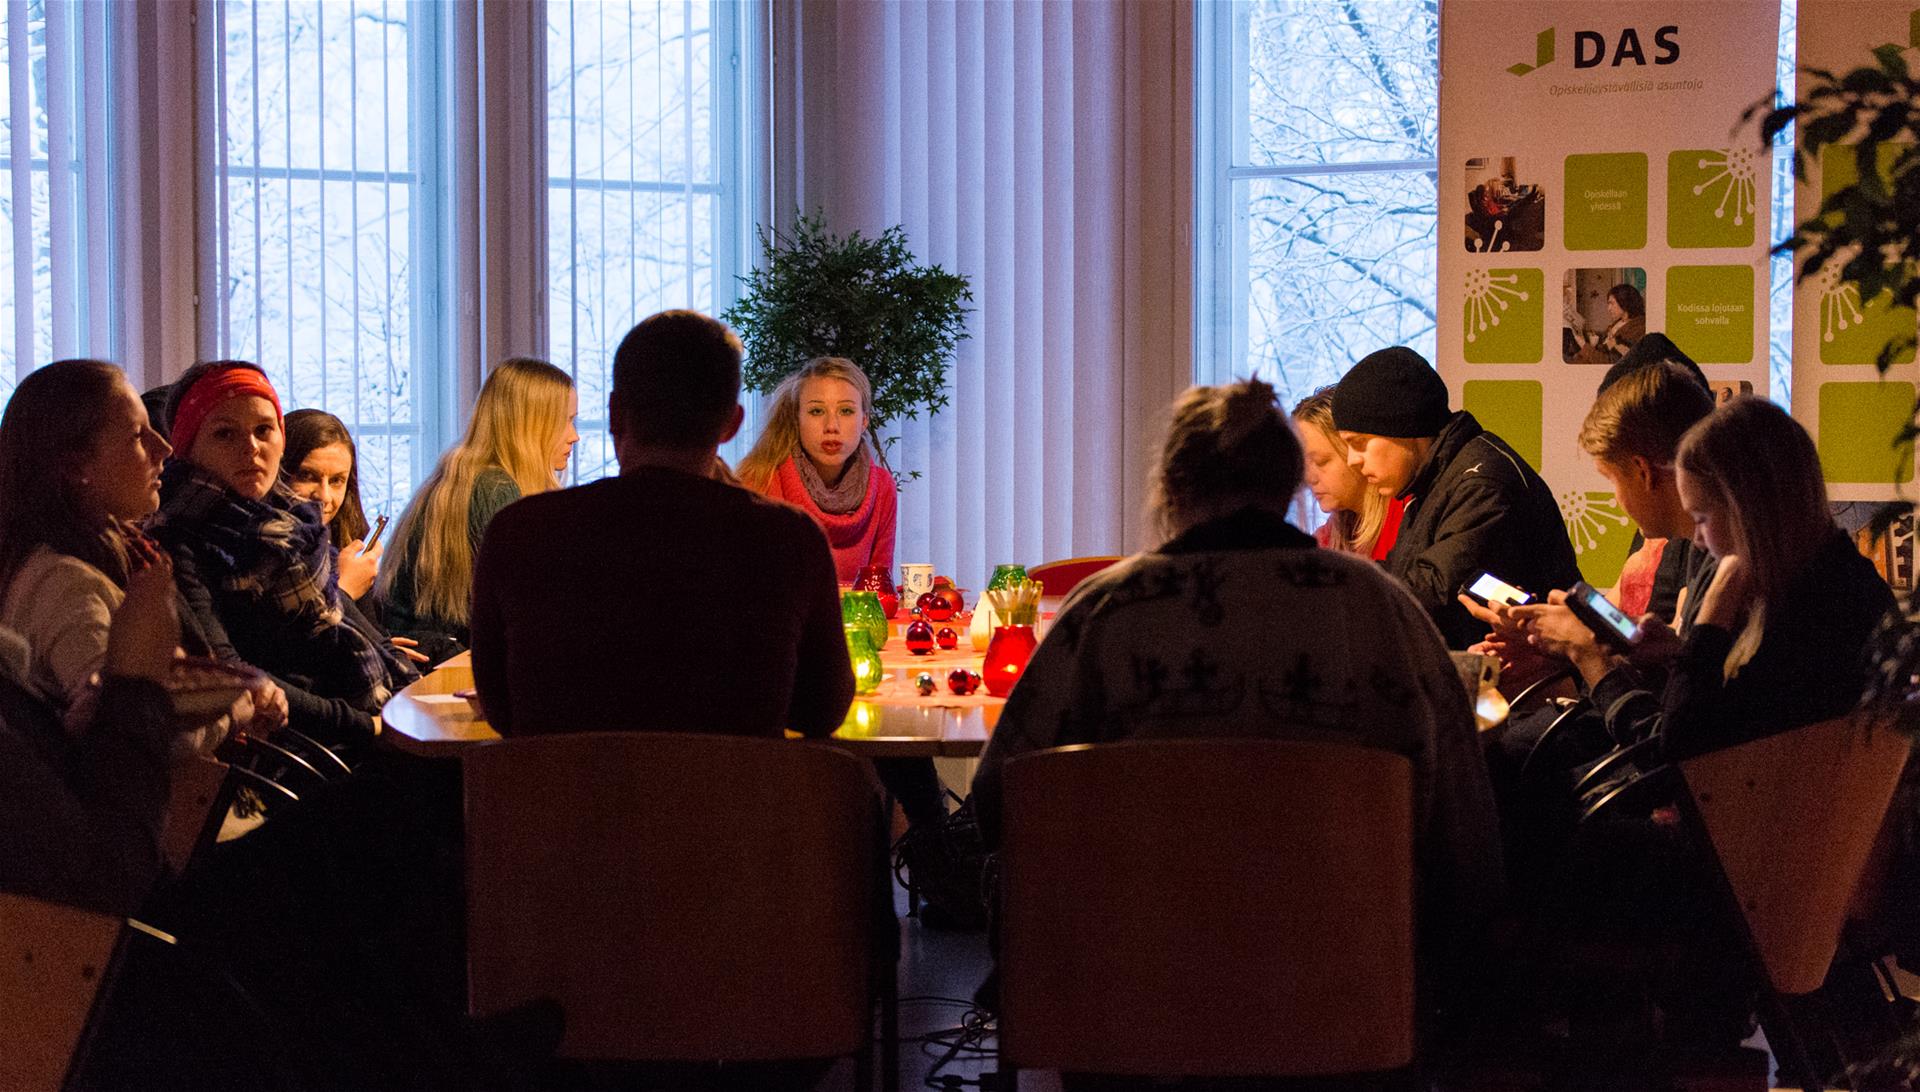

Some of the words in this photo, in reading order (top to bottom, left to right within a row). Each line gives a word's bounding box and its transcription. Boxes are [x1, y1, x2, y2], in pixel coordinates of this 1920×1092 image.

[1574, 26, 1680, 69] DAS
[1656, 78, 1704, 92] asuntoja
[1584, 188, 1628, 200] Opiskellaan
[1676, 303, 1711, 313] Kodissa
[1711, 302, 1745, 314] lojutaan
[1694, 315, 1730, 325] sohvalla
